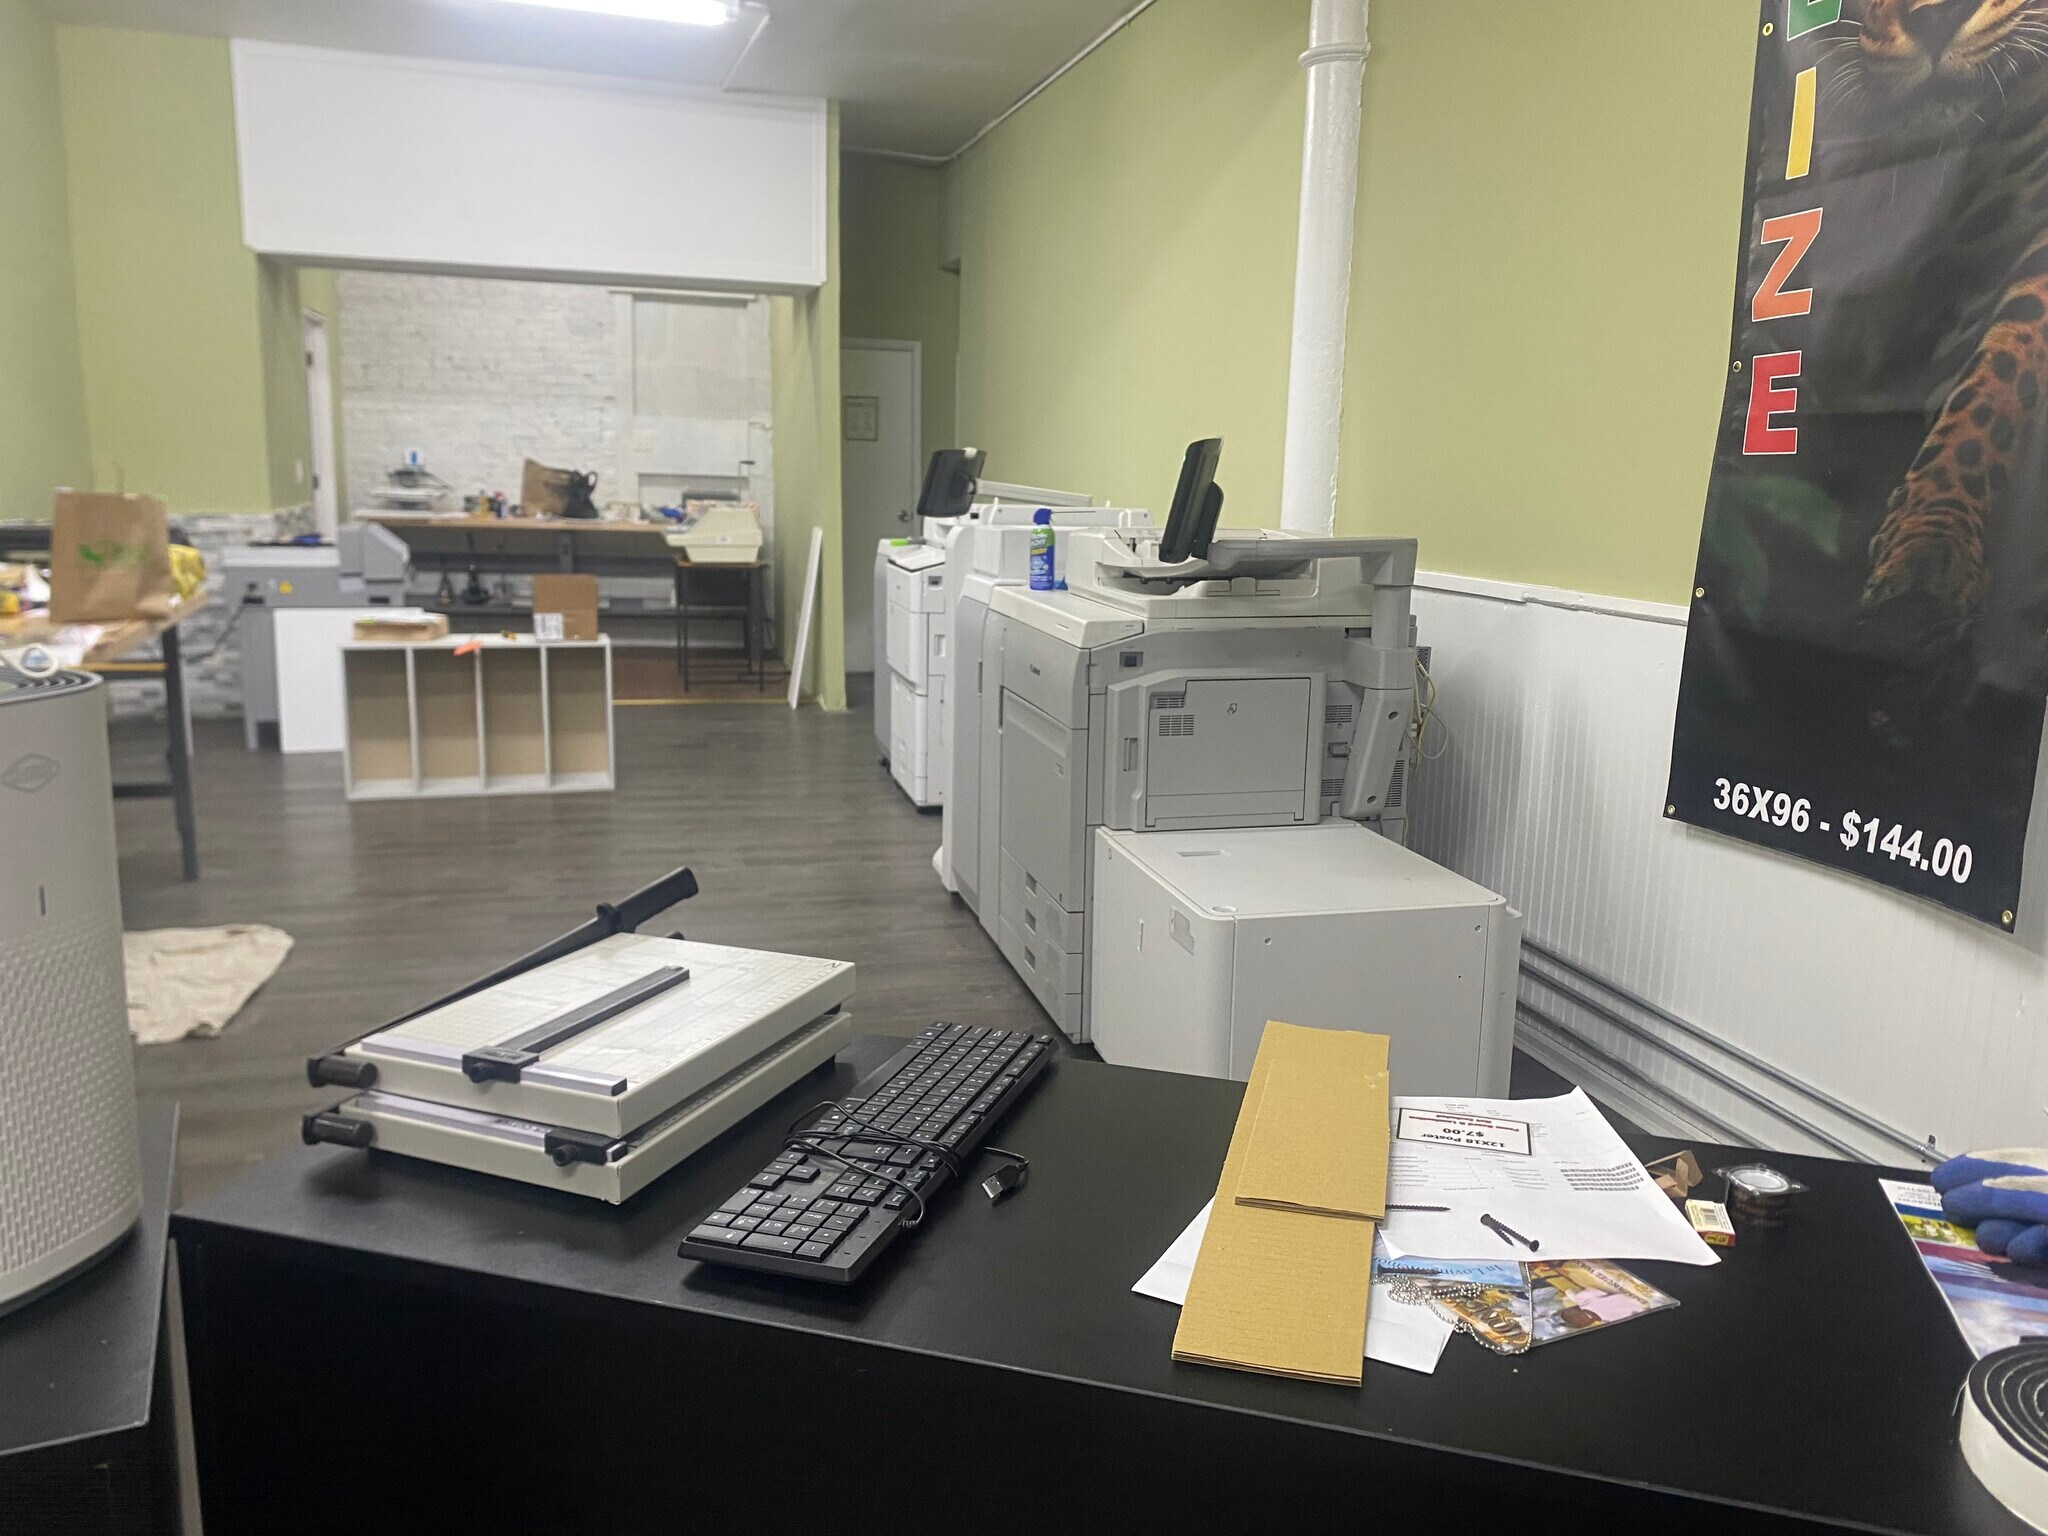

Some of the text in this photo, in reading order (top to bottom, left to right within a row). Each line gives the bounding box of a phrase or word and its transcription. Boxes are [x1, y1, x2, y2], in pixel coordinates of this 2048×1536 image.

[1713, 777, 1973, 884] 36X96 - $144.00
[1443, 1128, 1484, 1137] $7.00
[1421, 1133, 1506, 1147] 12X18 Poster
[1434, 1266, 1485, 1275] Lovin
